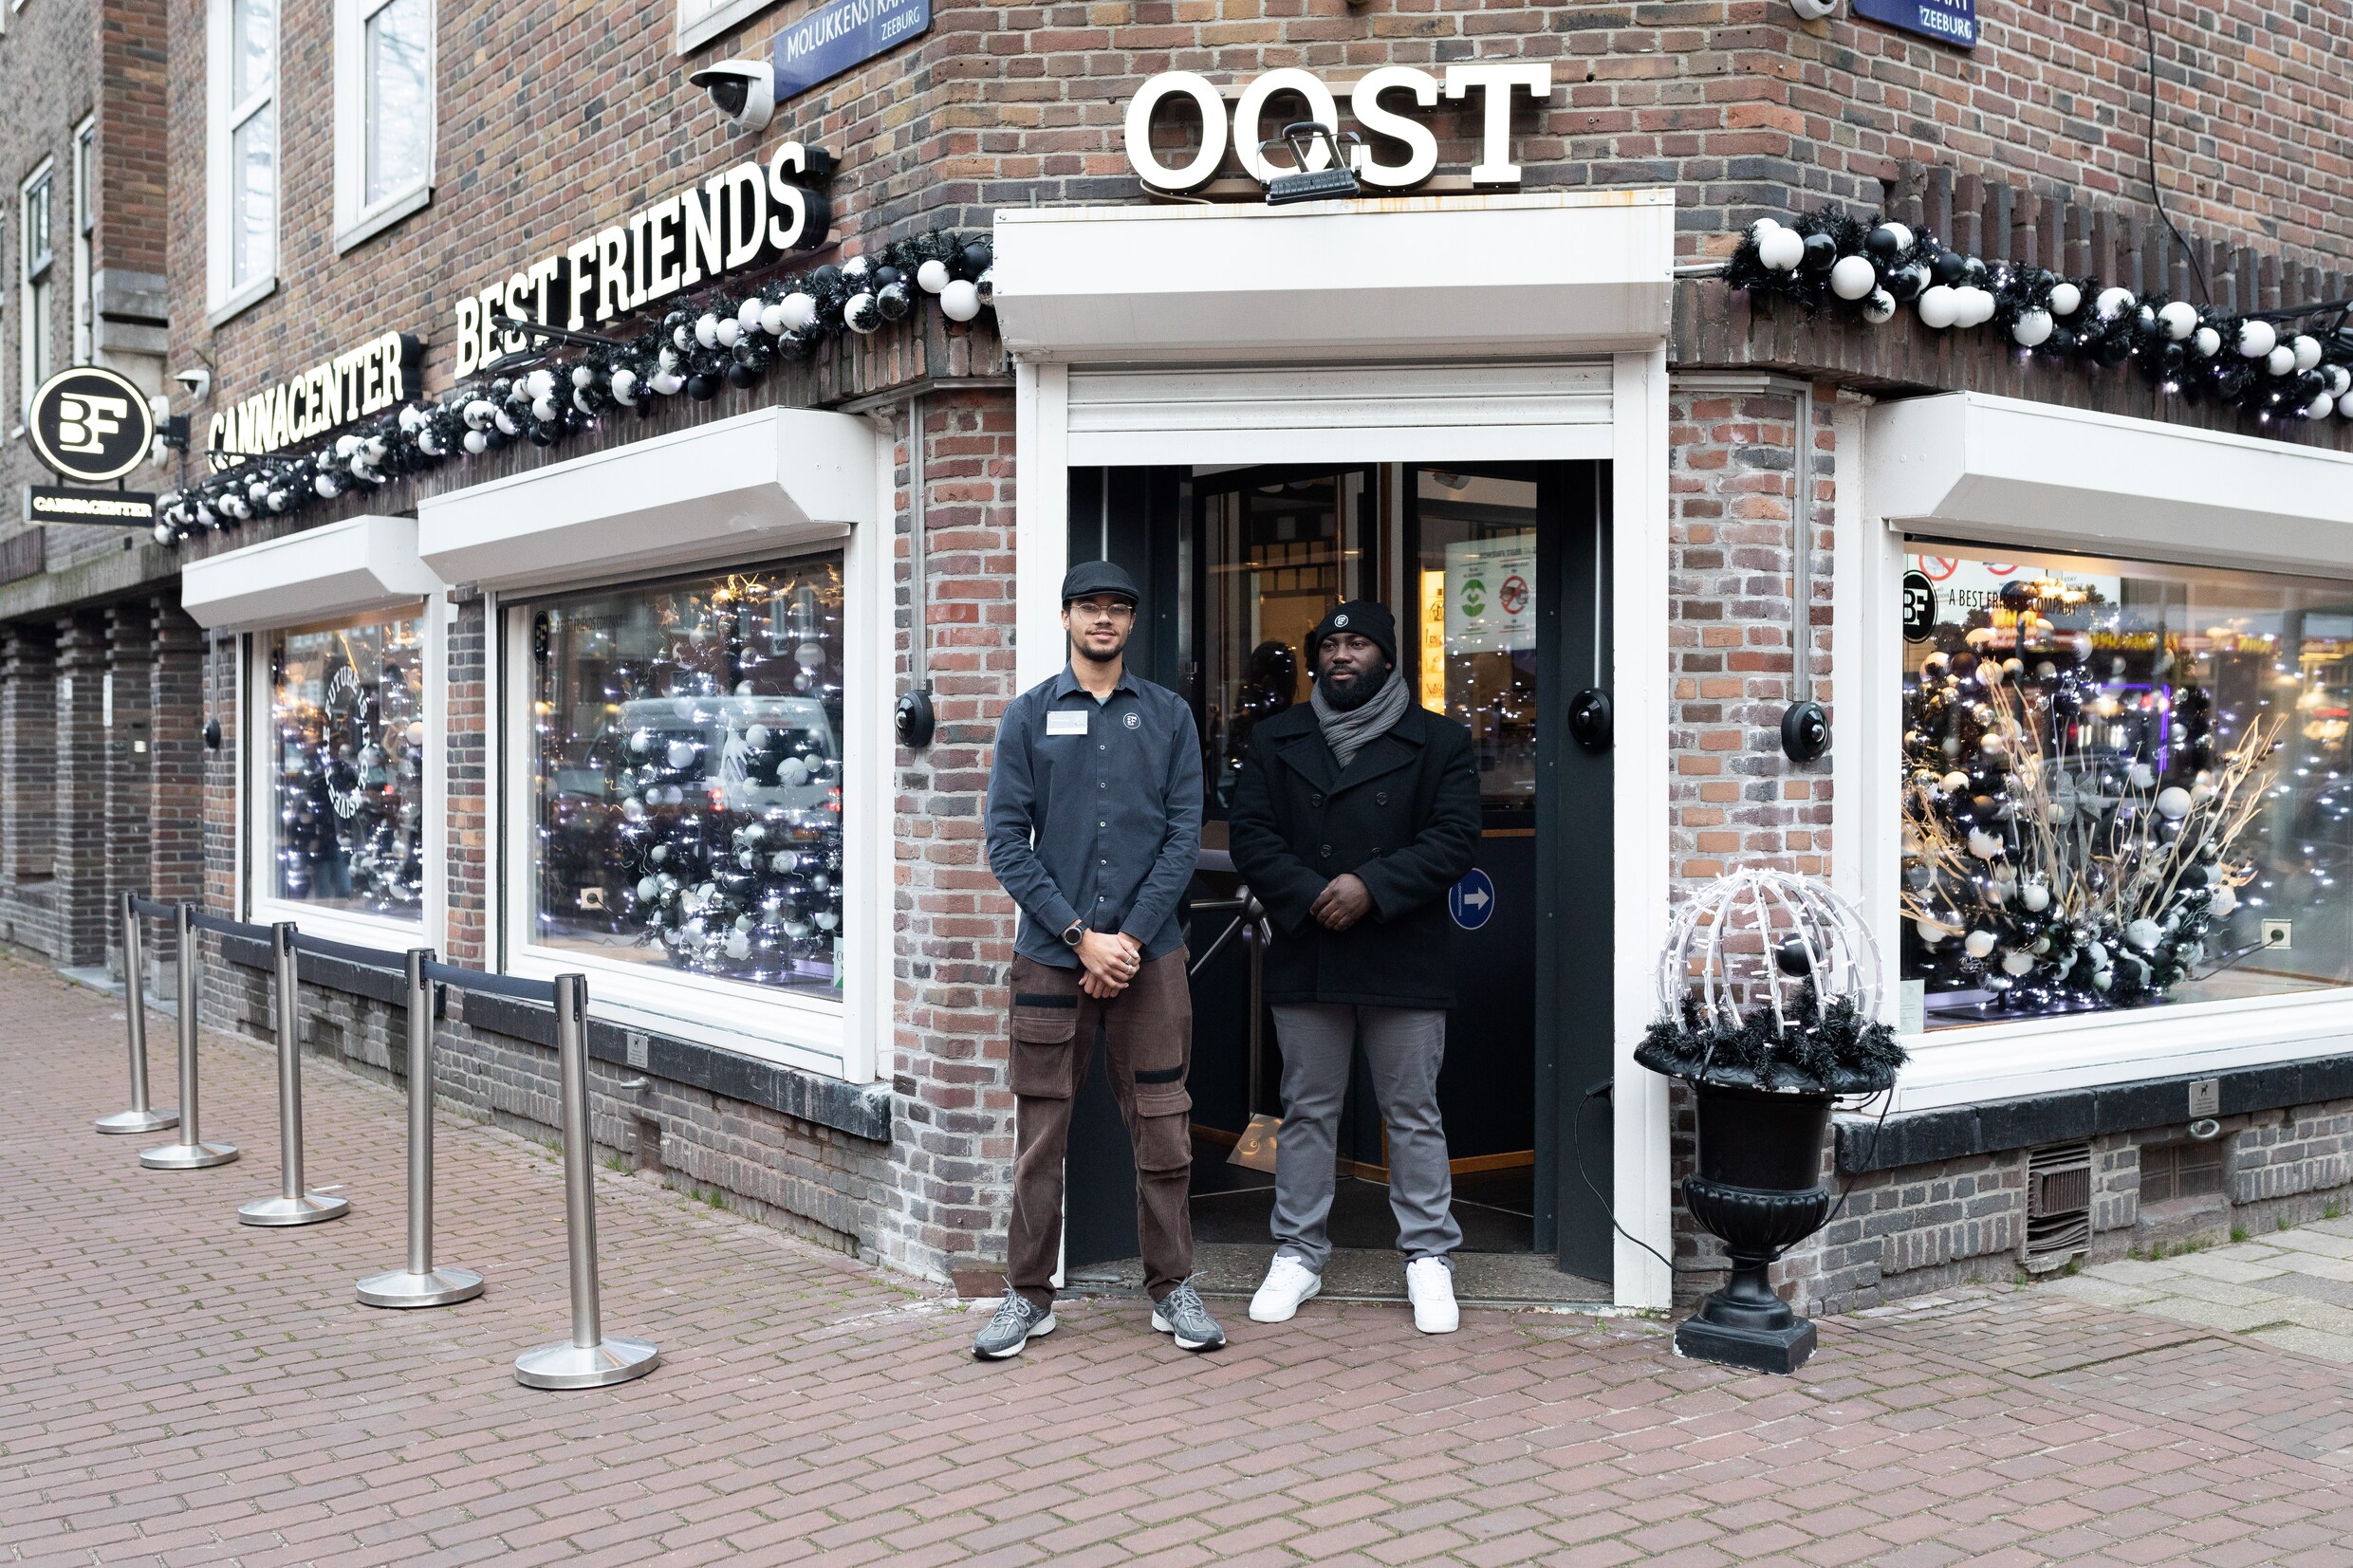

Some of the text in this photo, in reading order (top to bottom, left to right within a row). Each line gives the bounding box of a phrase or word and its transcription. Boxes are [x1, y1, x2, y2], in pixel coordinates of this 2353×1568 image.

[881, 6, 920, 41] ZEEBURG
[1922, 8, 1973, 39] ZEEBURG
[1124, 64, 1551, 189] OOST
[208, 140, 806, 474] CANNACENTER BEST FRIENDS
[59, 392, 128, 455] BF
[33, 496, 153, 518] CANNACENTER
[1949, 588, 1955, 606] A
[1959, 589, 1983, 610] BEST
[2032, 596, 2078, 617] COMPANY
[324, 666, 361, 722] FUTURE
[357, 687, 367, 719] IS
